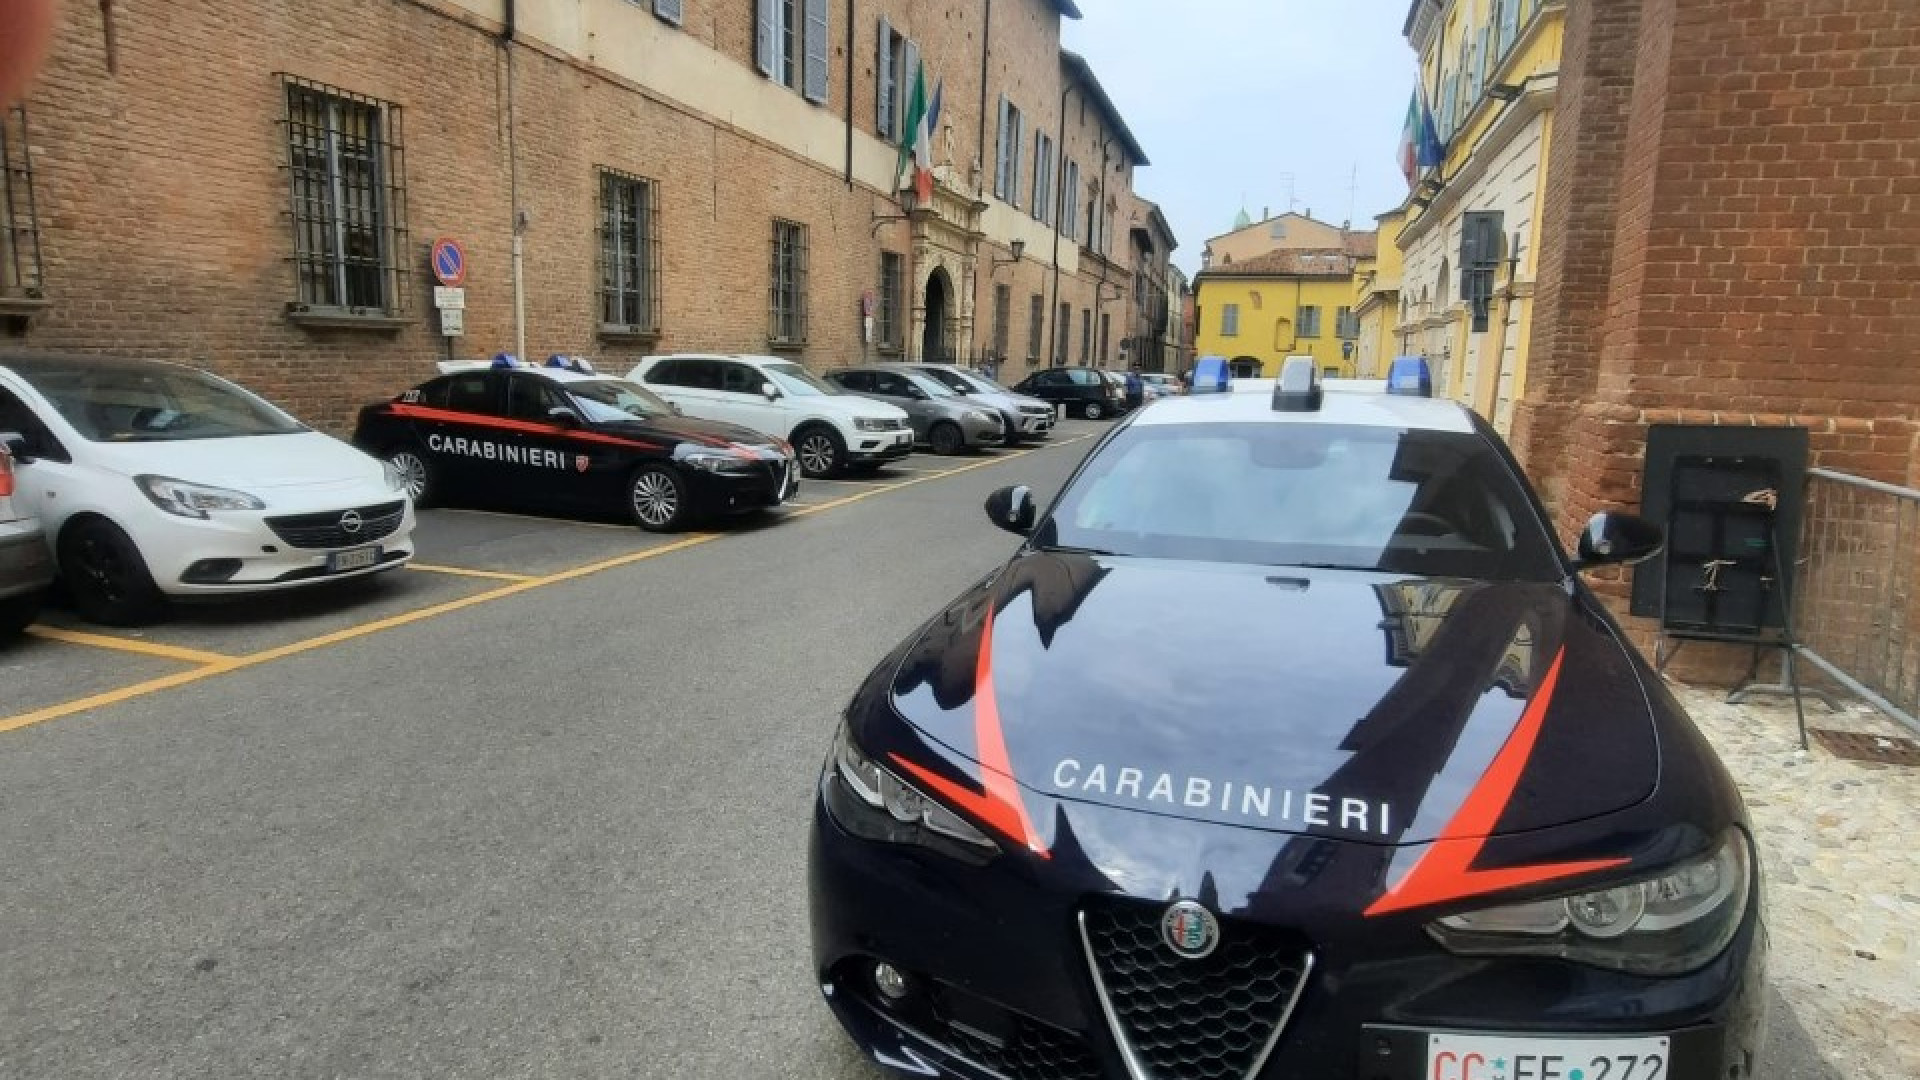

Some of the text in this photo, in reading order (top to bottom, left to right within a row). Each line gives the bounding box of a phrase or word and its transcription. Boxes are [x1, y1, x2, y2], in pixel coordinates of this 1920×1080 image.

[429, 433, 565, 470] CARABINIERI
[1053, 759, 1391, 836] CARABINIERI
[1590, 1054, 1662, 1080] 272
